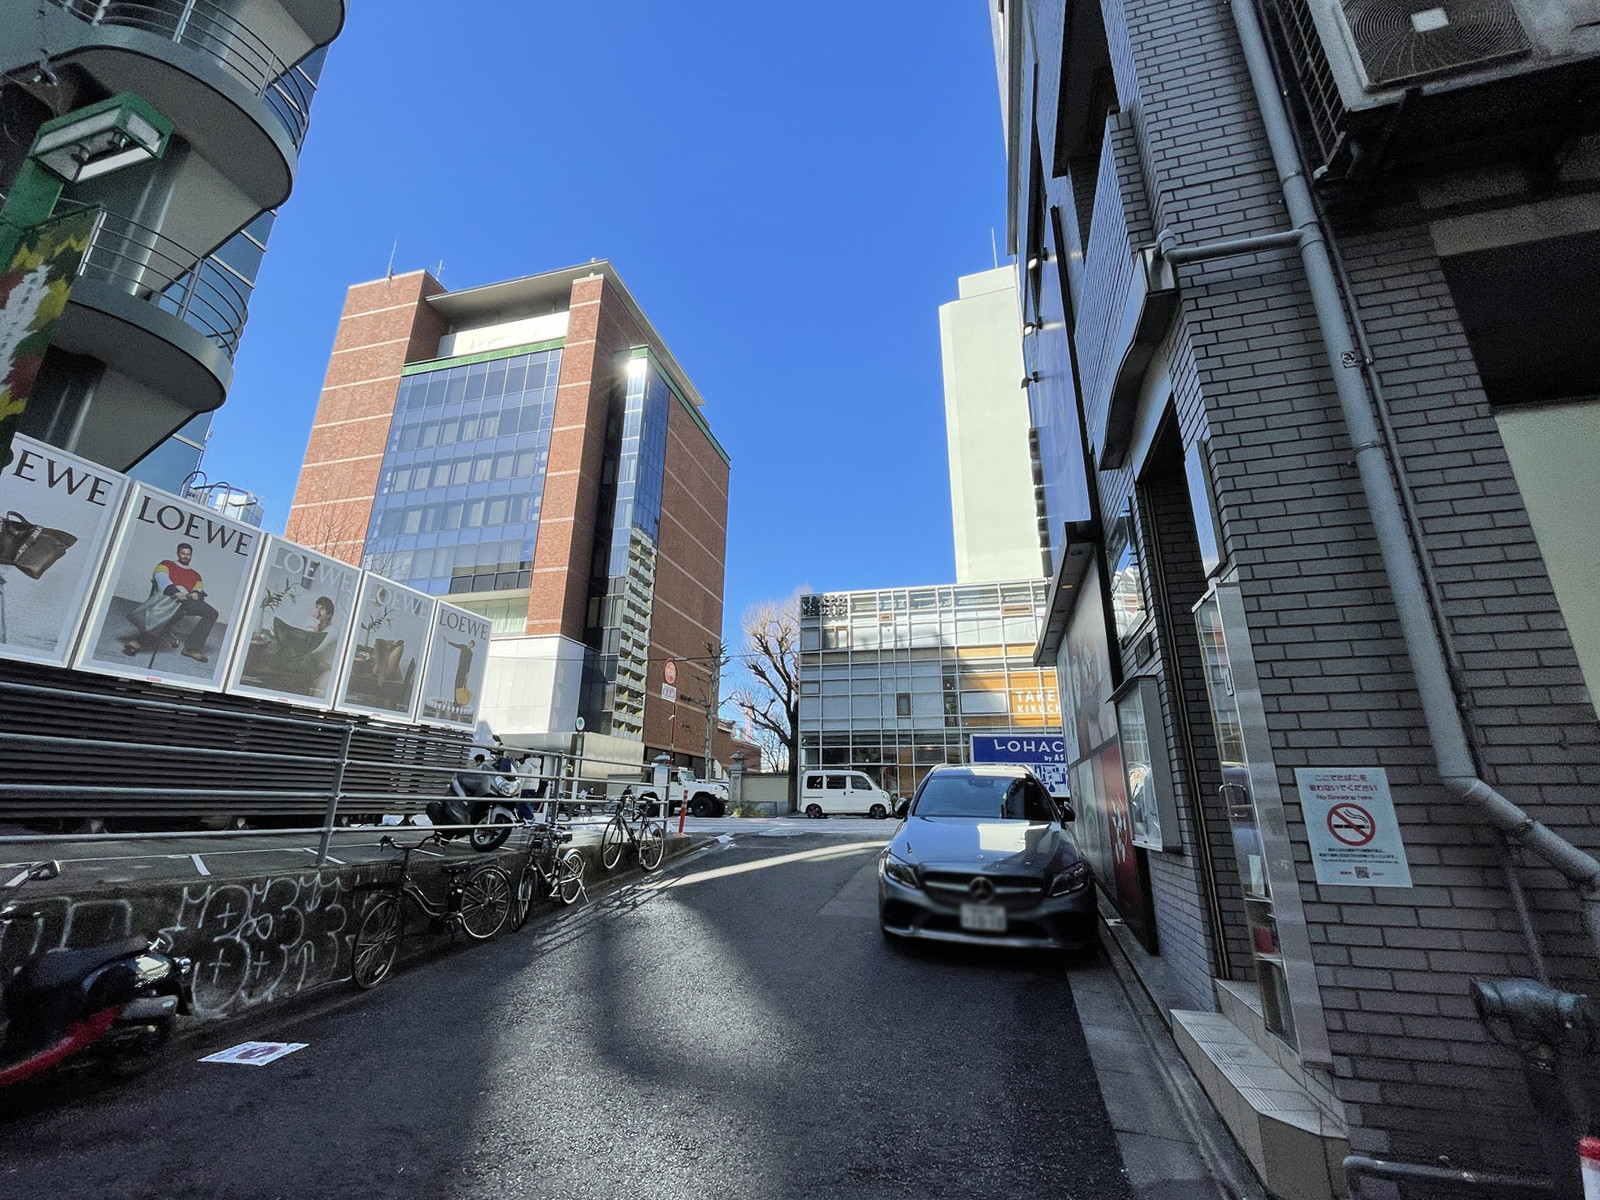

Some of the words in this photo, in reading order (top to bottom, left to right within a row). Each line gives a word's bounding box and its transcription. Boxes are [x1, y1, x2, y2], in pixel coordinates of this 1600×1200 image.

[137, 495, 253, 557] LOEWE
[270, 546, 356, 593] LOEWE
[439, 608, 489, 641] LOEWE
[993, 738, 1064, 753] LOHAC
[1044, 755, 1052, 763] by
